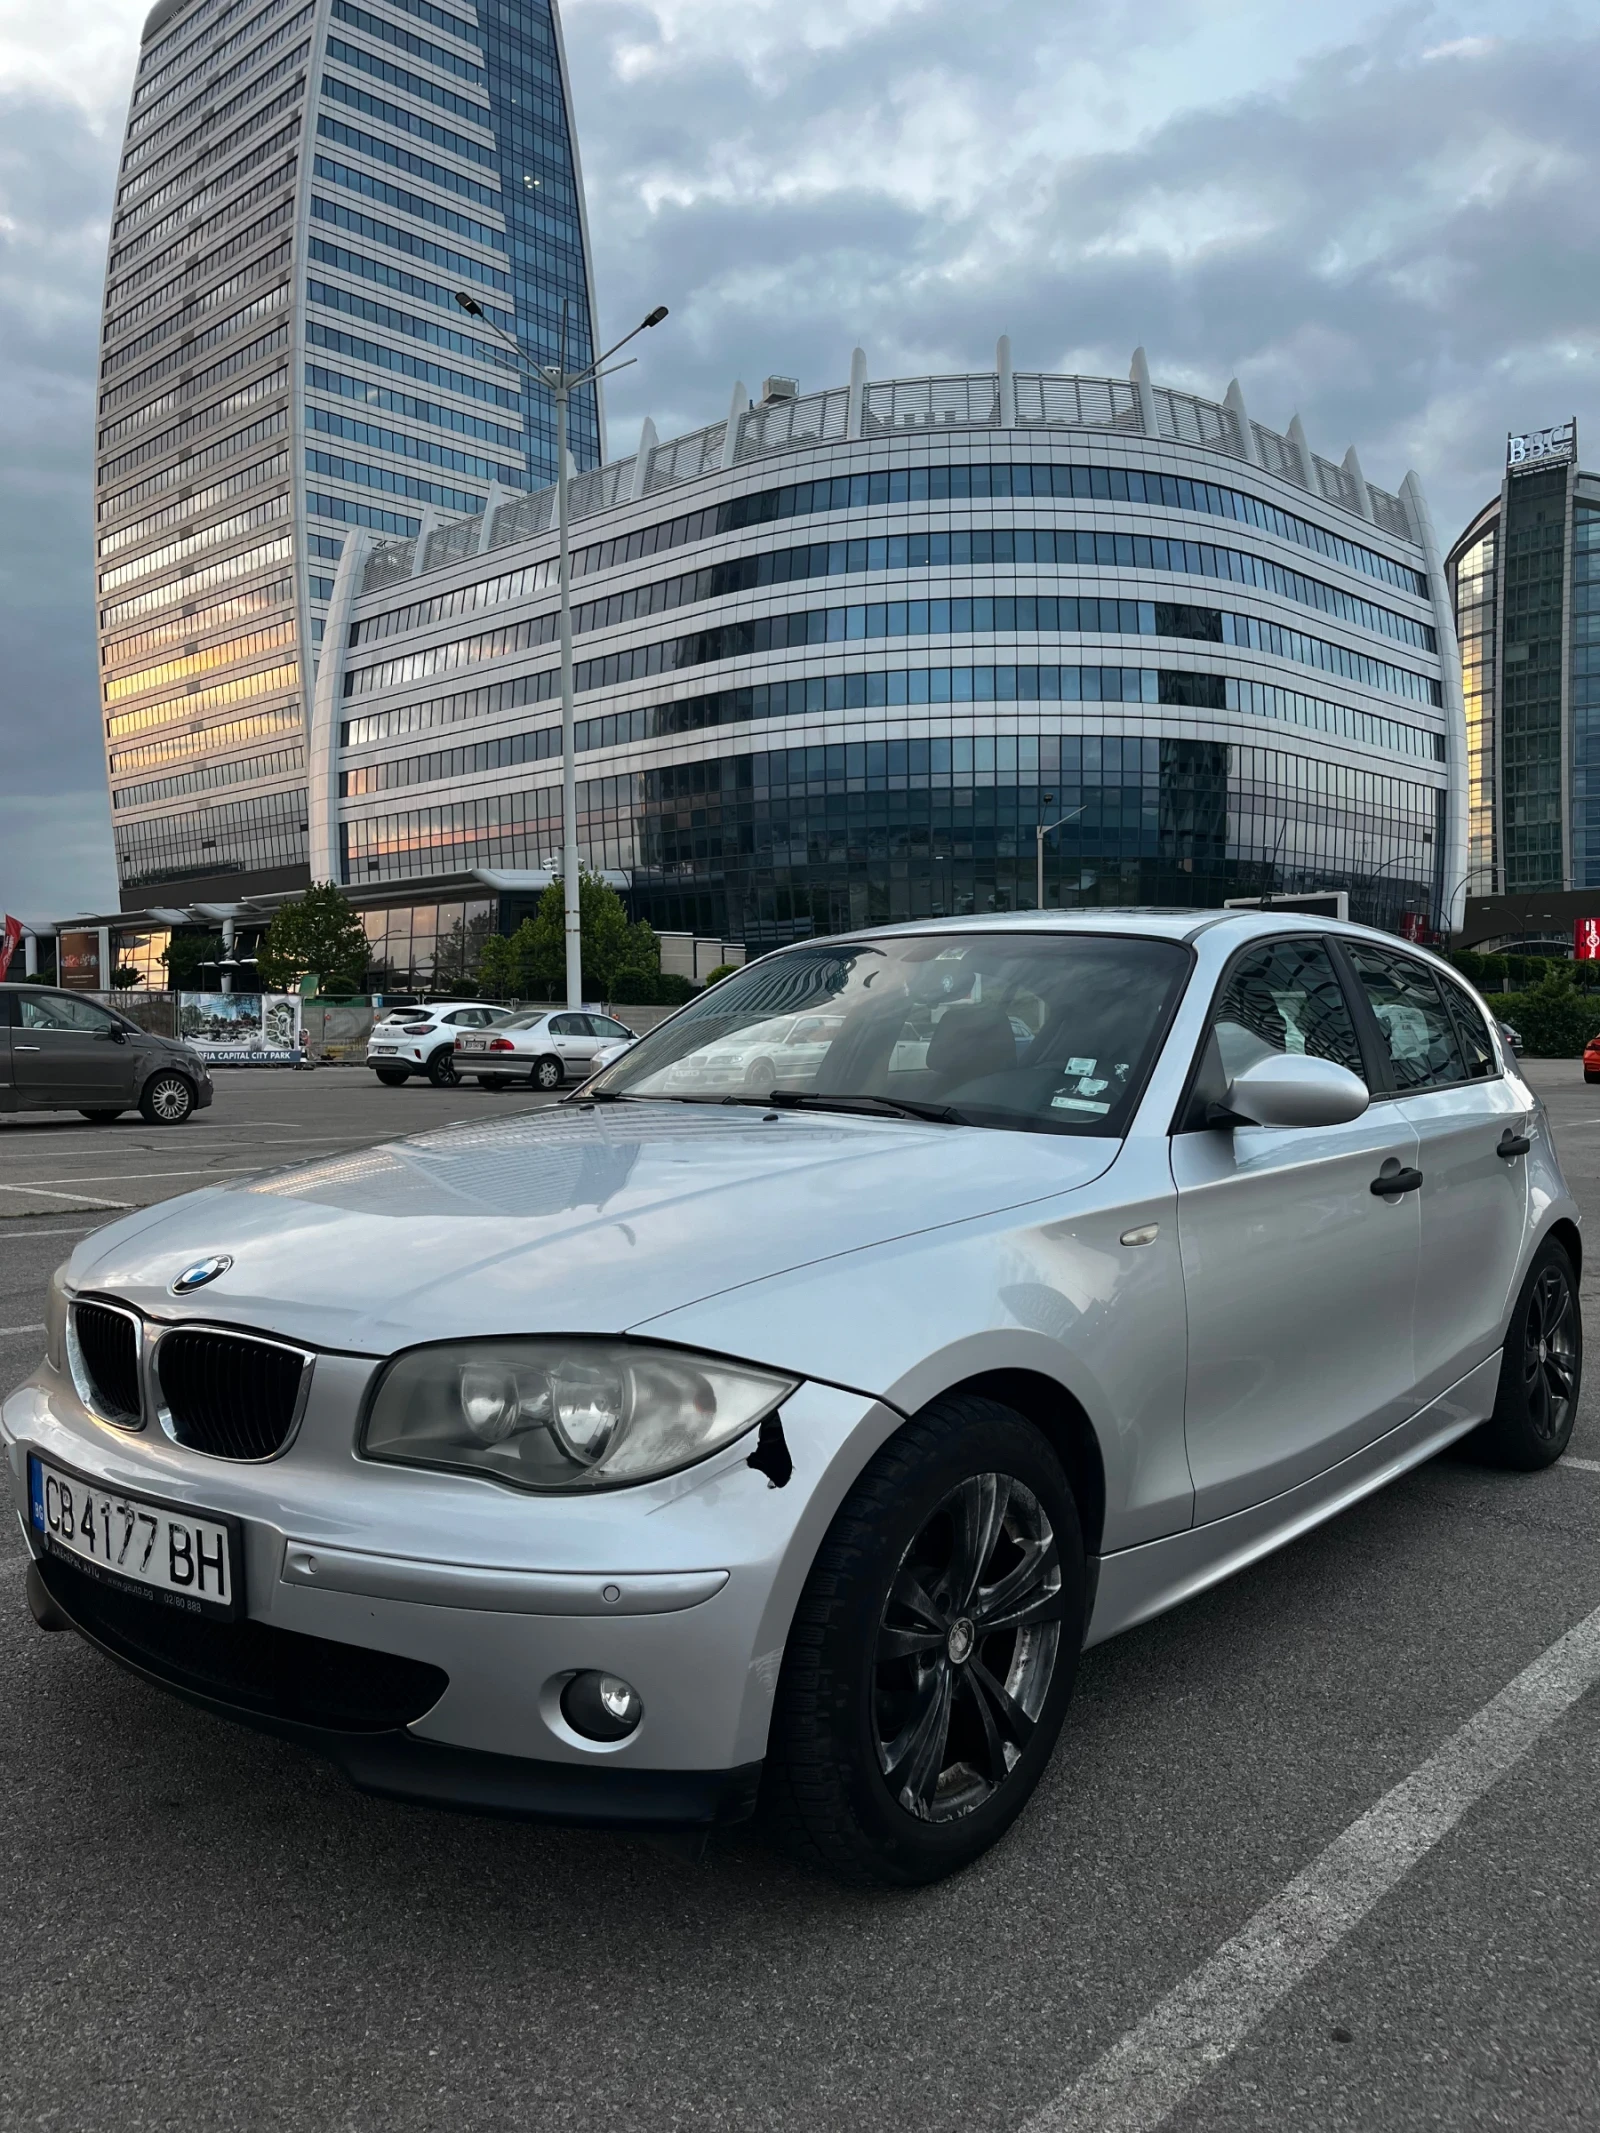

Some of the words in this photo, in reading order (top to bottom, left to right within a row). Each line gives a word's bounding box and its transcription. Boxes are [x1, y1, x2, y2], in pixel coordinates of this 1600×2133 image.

[1508, 425, 1564, 464] BBC
[218, 1051, 249, 1060] CAPITAL
[251, 1051, 268, 1060] CITY
[270, 1051, 291, 1060] PARK
[81, 1494, 158, 1573] 4177
